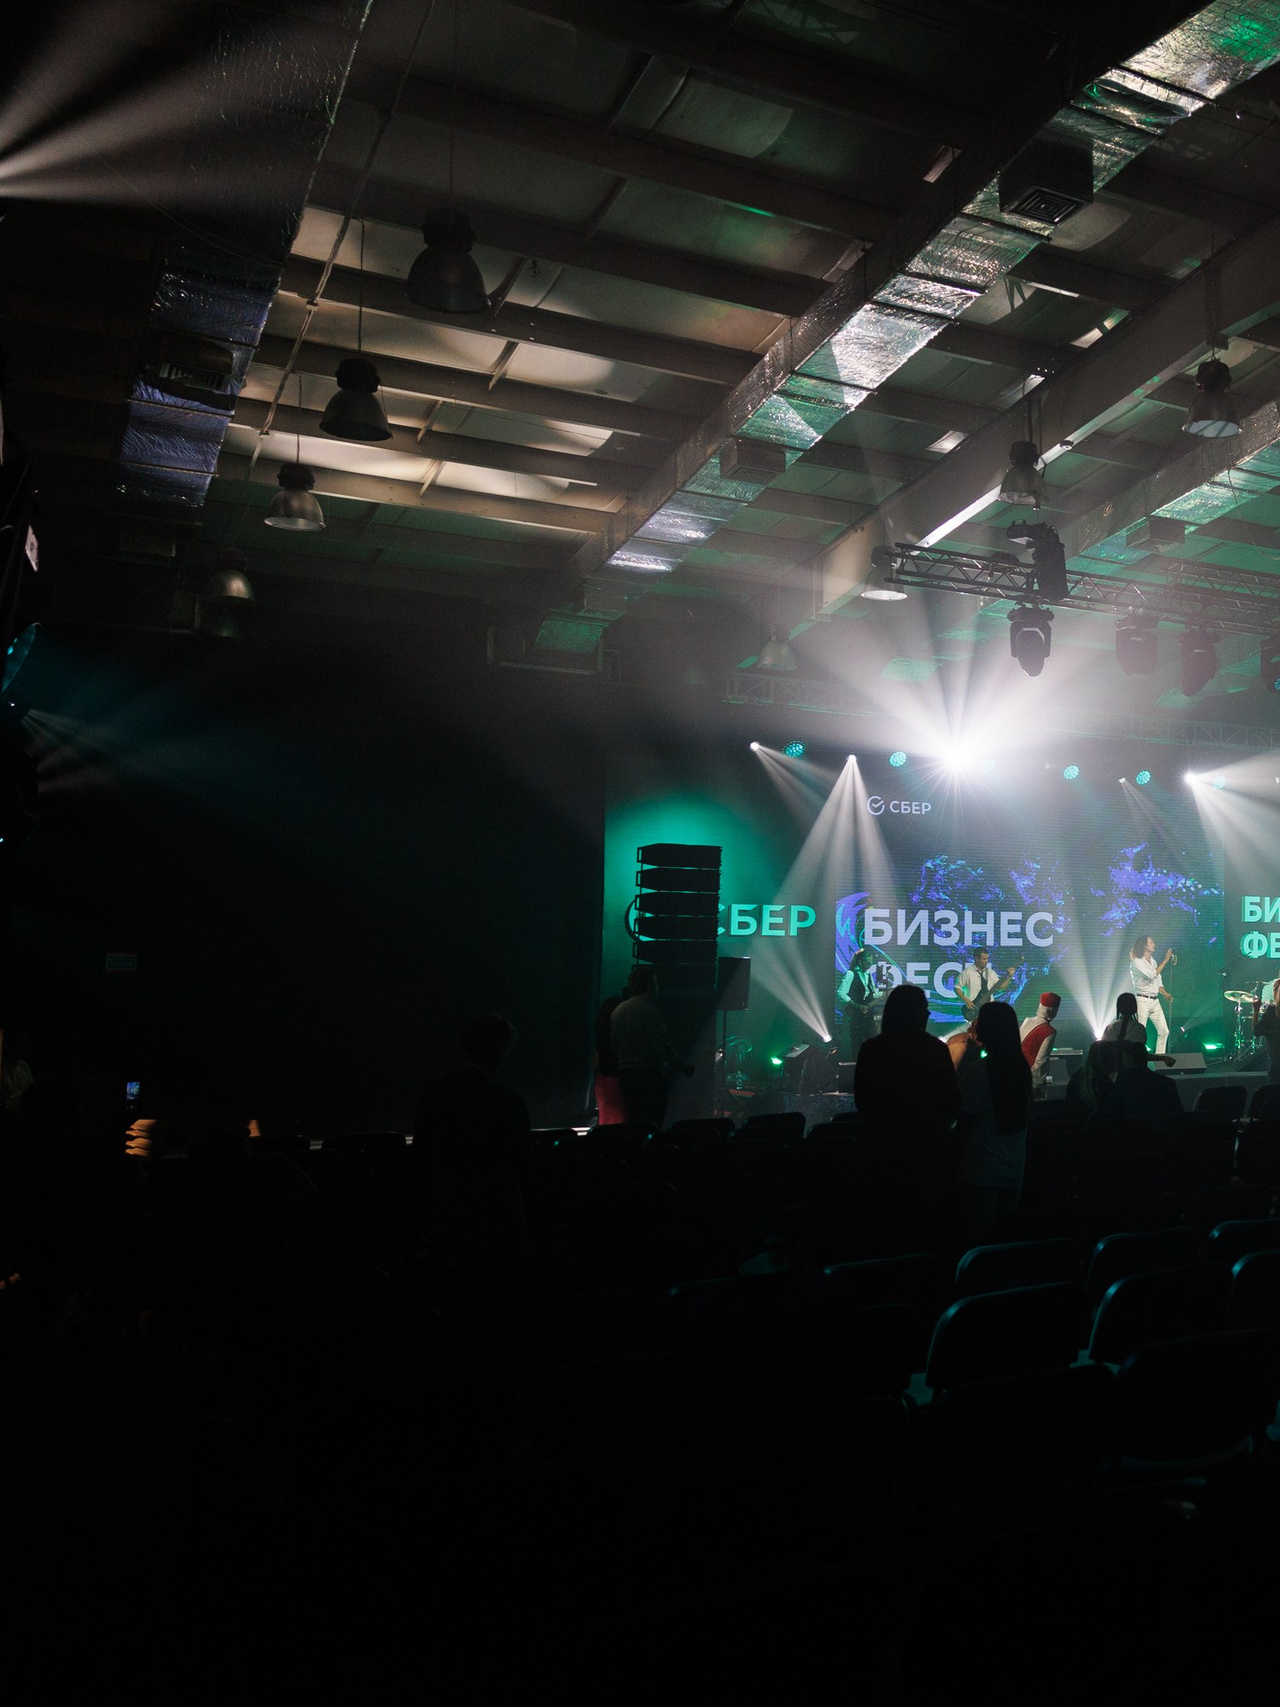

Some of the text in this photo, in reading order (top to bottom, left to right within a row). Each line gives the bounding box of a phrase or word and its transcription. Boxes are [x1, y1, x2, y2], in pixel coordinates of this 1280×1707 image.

[889, 800, 932, 815] СБЕР
[717, 903, 817, 937] БЕР
[863, 908, 1054, 948] БИЗНЕС
[865, 961, 993, 999] ФЕС
